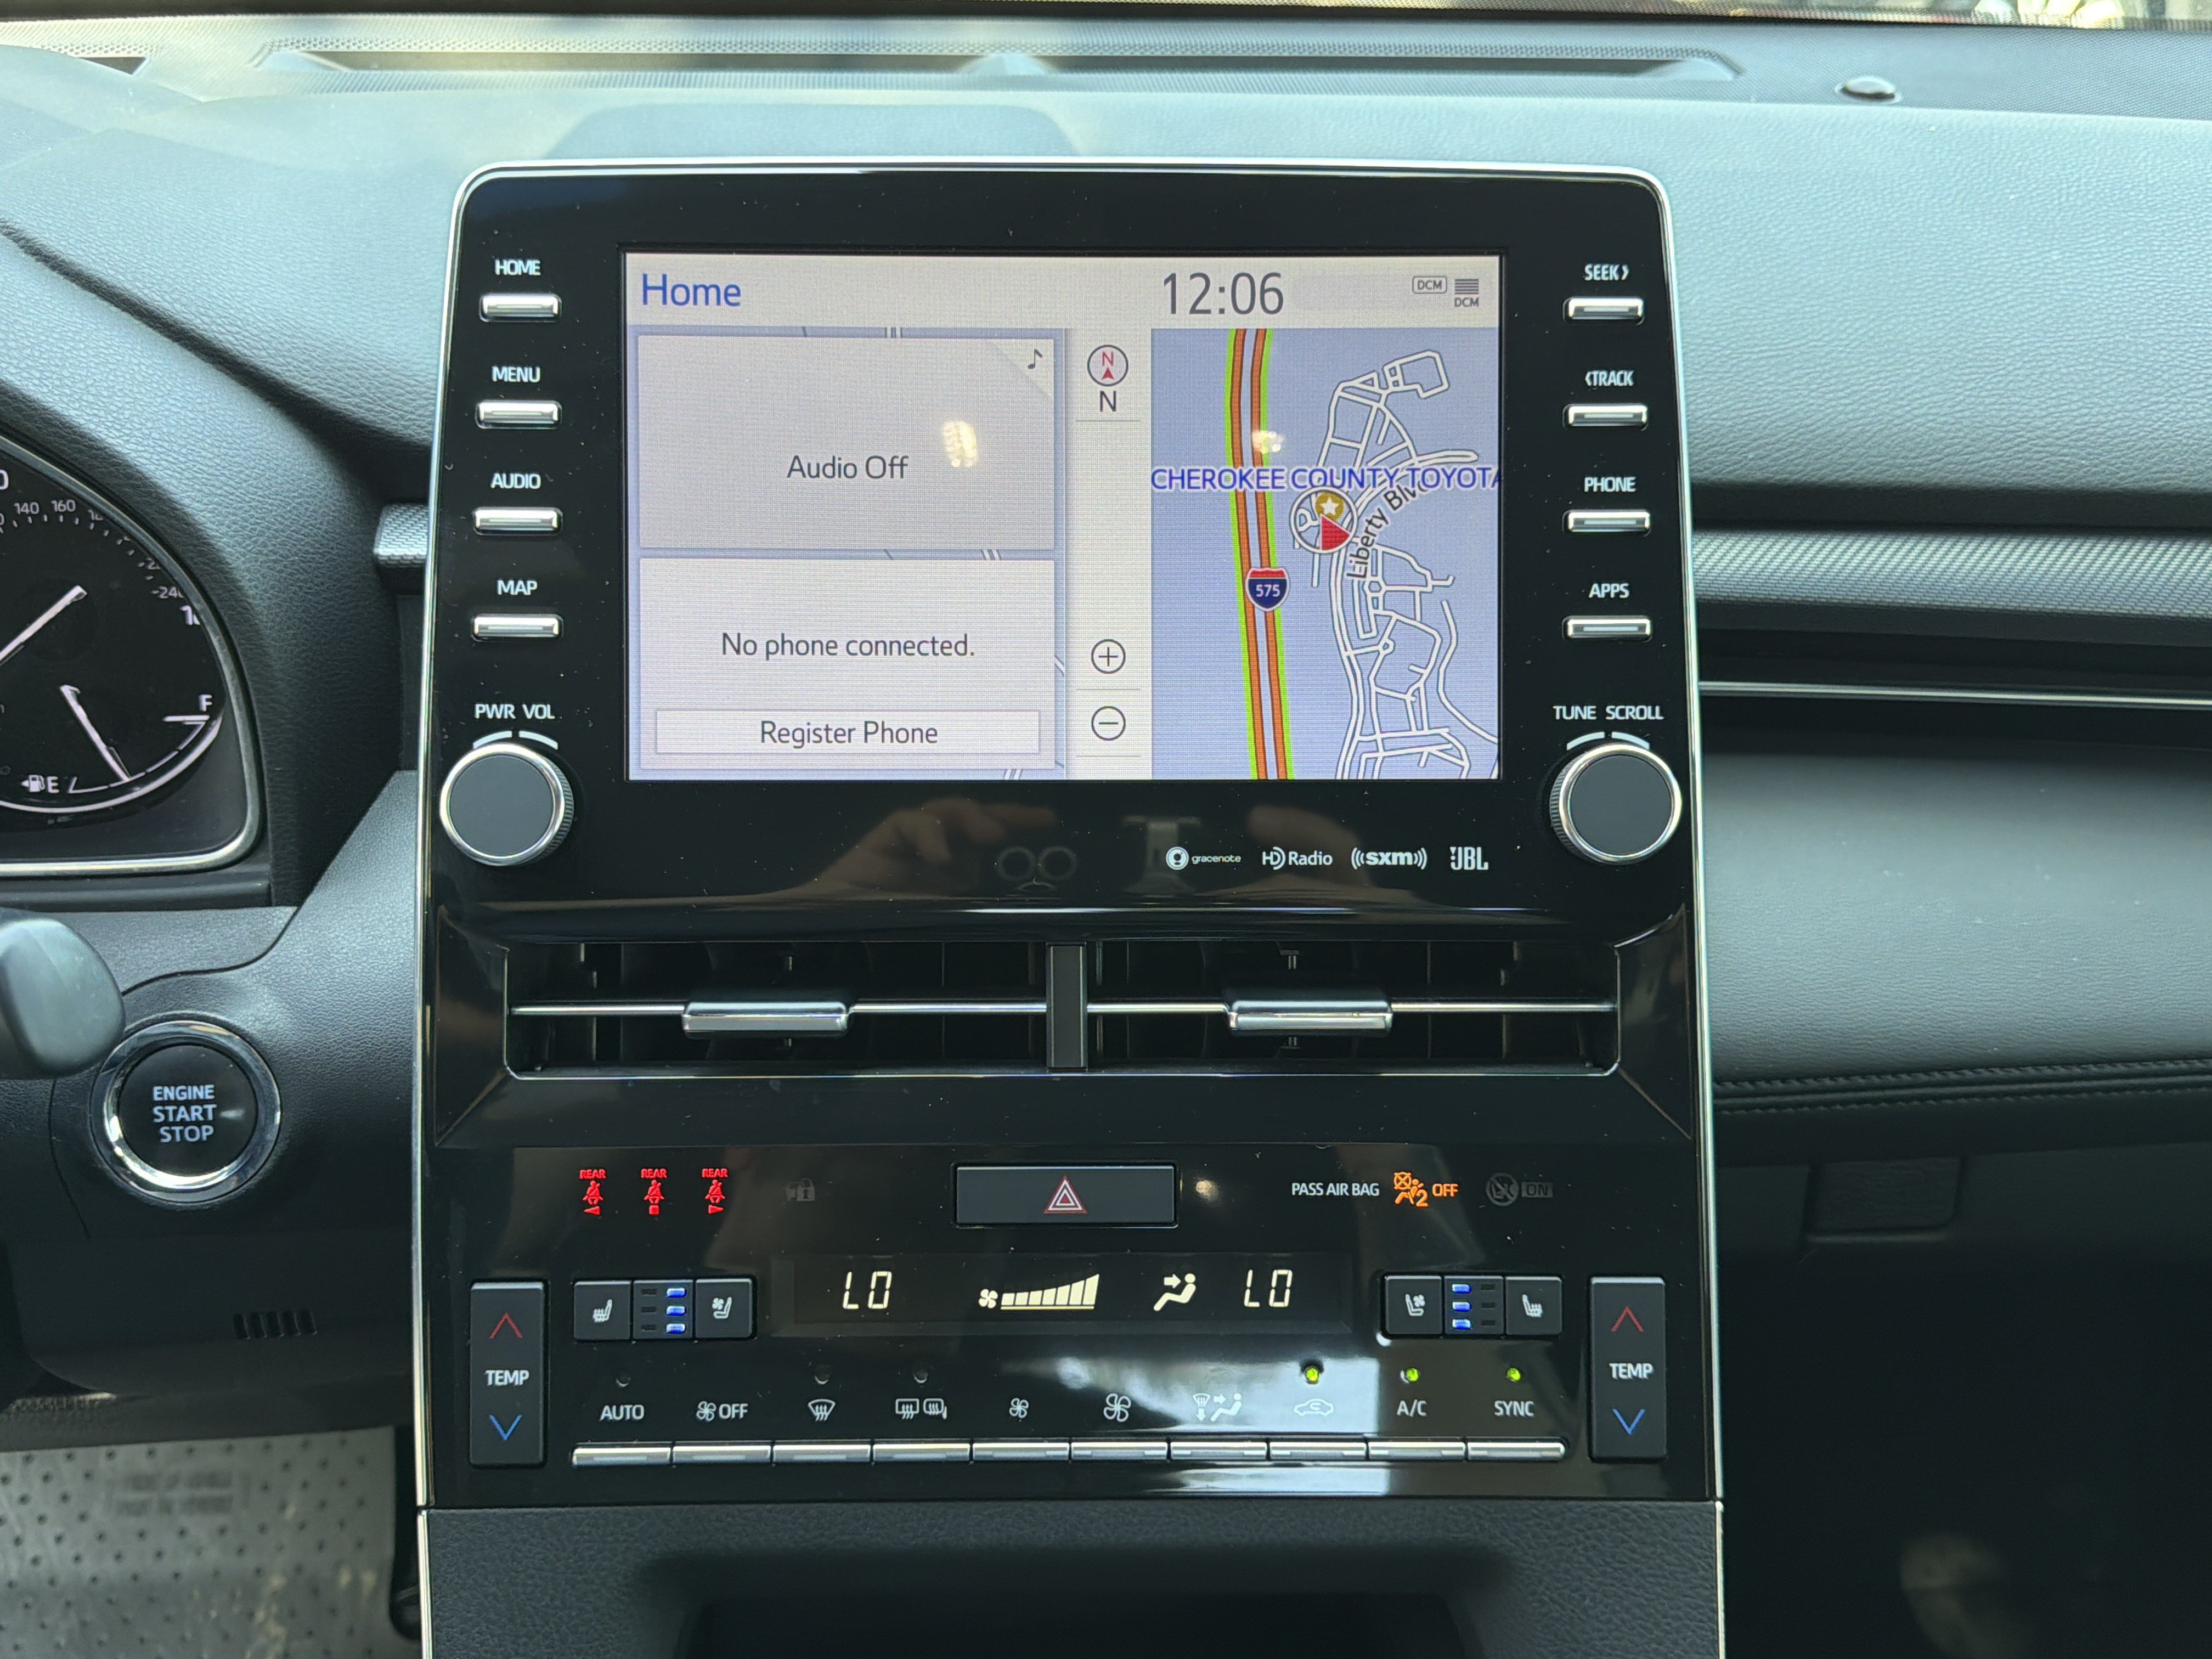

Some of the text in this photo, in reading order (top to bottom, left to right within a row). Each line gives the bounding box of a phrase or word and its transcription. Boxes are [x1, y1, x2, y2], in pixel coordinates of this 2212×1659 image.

[495, 259, 541, 275] HOME
[1584, 263, 1620, 281] SEEK
[642, 273, 741, 307] Home
[1417, 280, 1442, 290] DCM
[1164, 272, 1284, 315] 12:06
[1454, 297, 1479, 307] DCM
[1100, 349, 1115, 367] N
[492, 366, 540, 383] MENU
[1592, 370, 1634, 386] TRACK
[1099, 391, 1116, 412] N
[787, 455, 909, 479] Audio Off
[490, 473, 541, 489] AUDIO
[1152, 469, 1285, 489] CHEROKEE
[1291, 468, 1399, 489] COUNTY
[1584, 477, 1636, 492] PHONE
[14, 501, 40, 515] 140
[51, 499, 76, 512] 160
[1346, 507, 1389, 578] Liberty
[497, 580, 538, 595] MAP
[1256, 584, 1280, 597] 575
[1589, 583, 1629, 598] APPS
[723, 632, 975, 661] No phone connected.
[200, 694, 212, 712] F
[475, 703, 555, 719] PWR VOL
[1553, 705, 1664, 720] TUNE SCROLL
[761, 720, 938, 749] Register Phone
[47, 776, 59, 793] E
[1191, 854, 1242, 865] gracenote
[1262, 847, 1333, 870] HD Radio
[1450, 847, 1489, 871] JBL
[153, 1084, 215, 1101] ENGINE
[153, 1104, 217, 1123] START
[160, 1125, 214, 1143] STOP
[579, 1169, 606, 1180] REAR
[641, 1168, 667, 1179] REAR
[702, 1168, 728, 1178] REAR
[1291, 1182, 1380, 1197] PASS AIR BAG
[1432, 1183, 1458, 1197] OFF
[1527, 1183, 1549, 1196] ON
[486, 1370, 529, 1386] TEMP
[1609, 1363, 1653, 1379] TEMP
[600, 1404, 645, 1421] AUTO
[719, 1403, 748, 1419] OFF
[1397, 1399, 1426, 1417] A/C
[1494, 1400, 1534, 1417] SYNC
